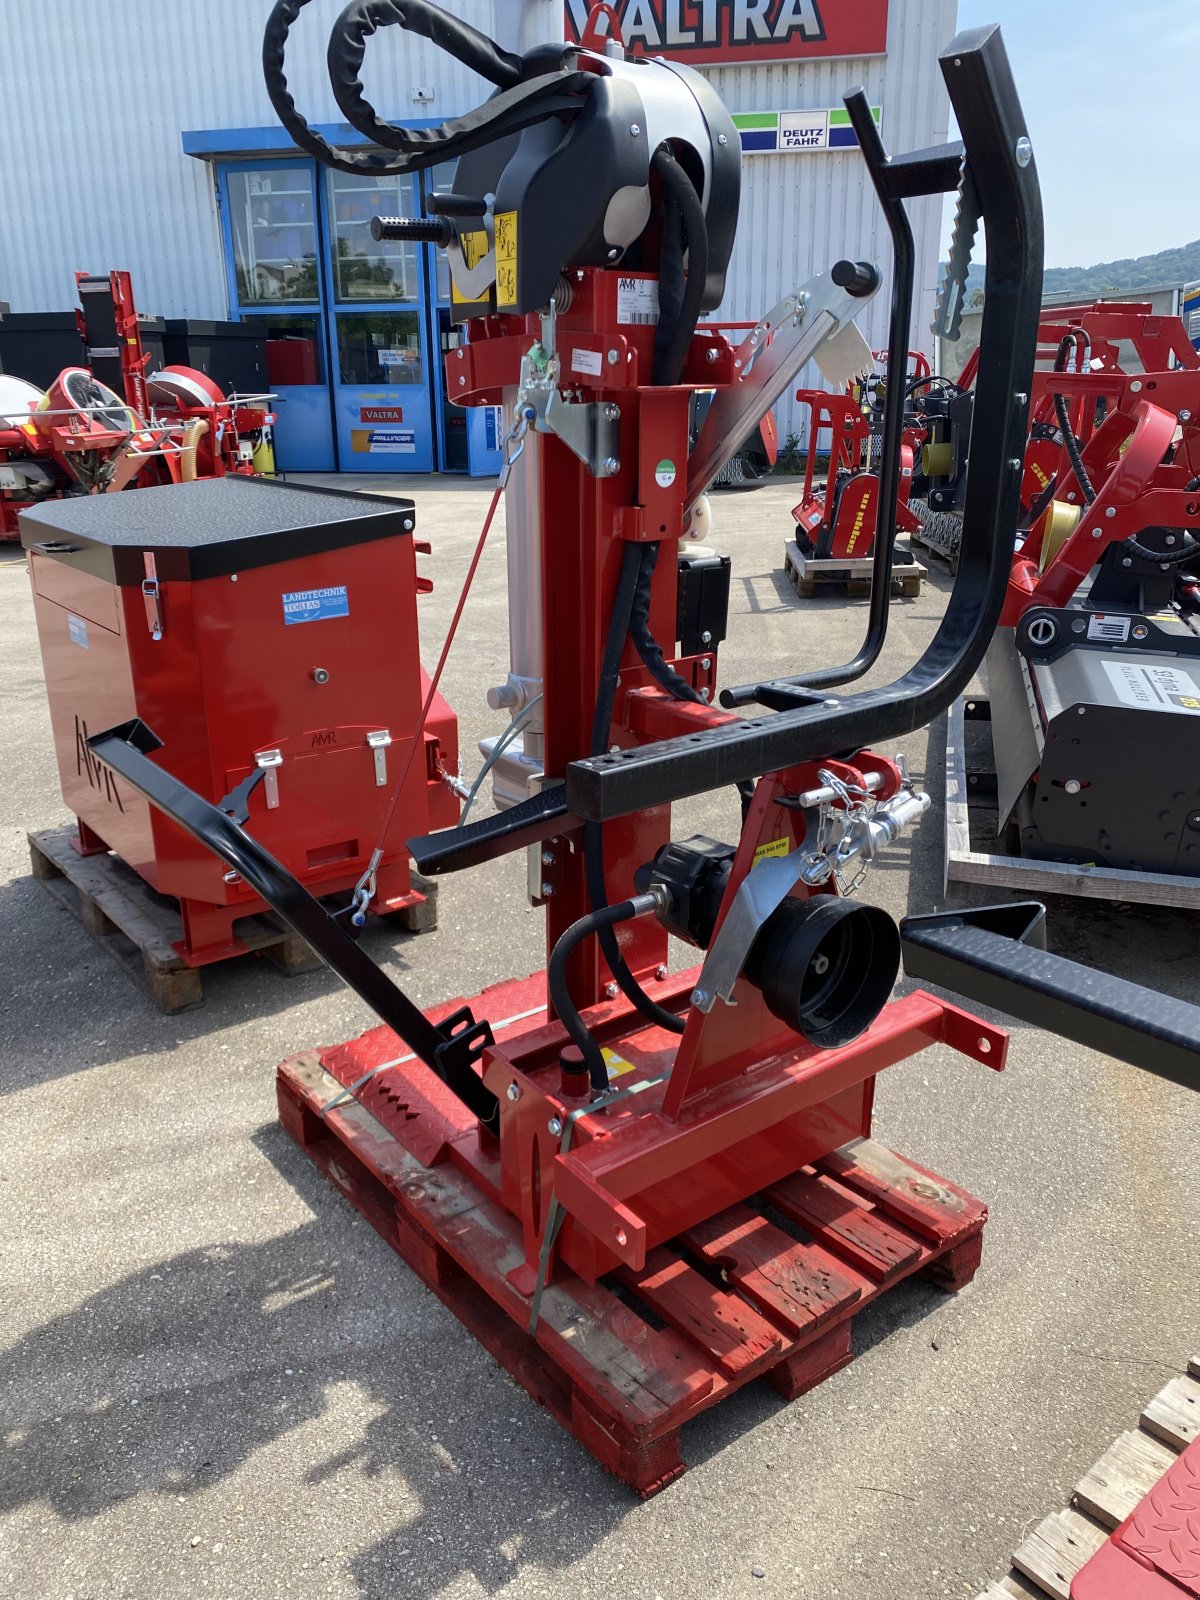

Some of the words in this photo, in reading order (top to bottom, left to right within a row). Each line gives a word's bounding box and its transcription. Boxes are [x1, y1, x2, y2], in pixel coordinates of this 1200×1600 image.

[783, 129, 823, 138] DEUTZ
[786, 137, 819, 146] FAHR
[366, 410, 399, 420] VALTRA
[283, 587, 346, 603] LANDTECHNIK
[286, 601, 319, 612] TOBIAS
[311, 731, 337, 748] AMR
